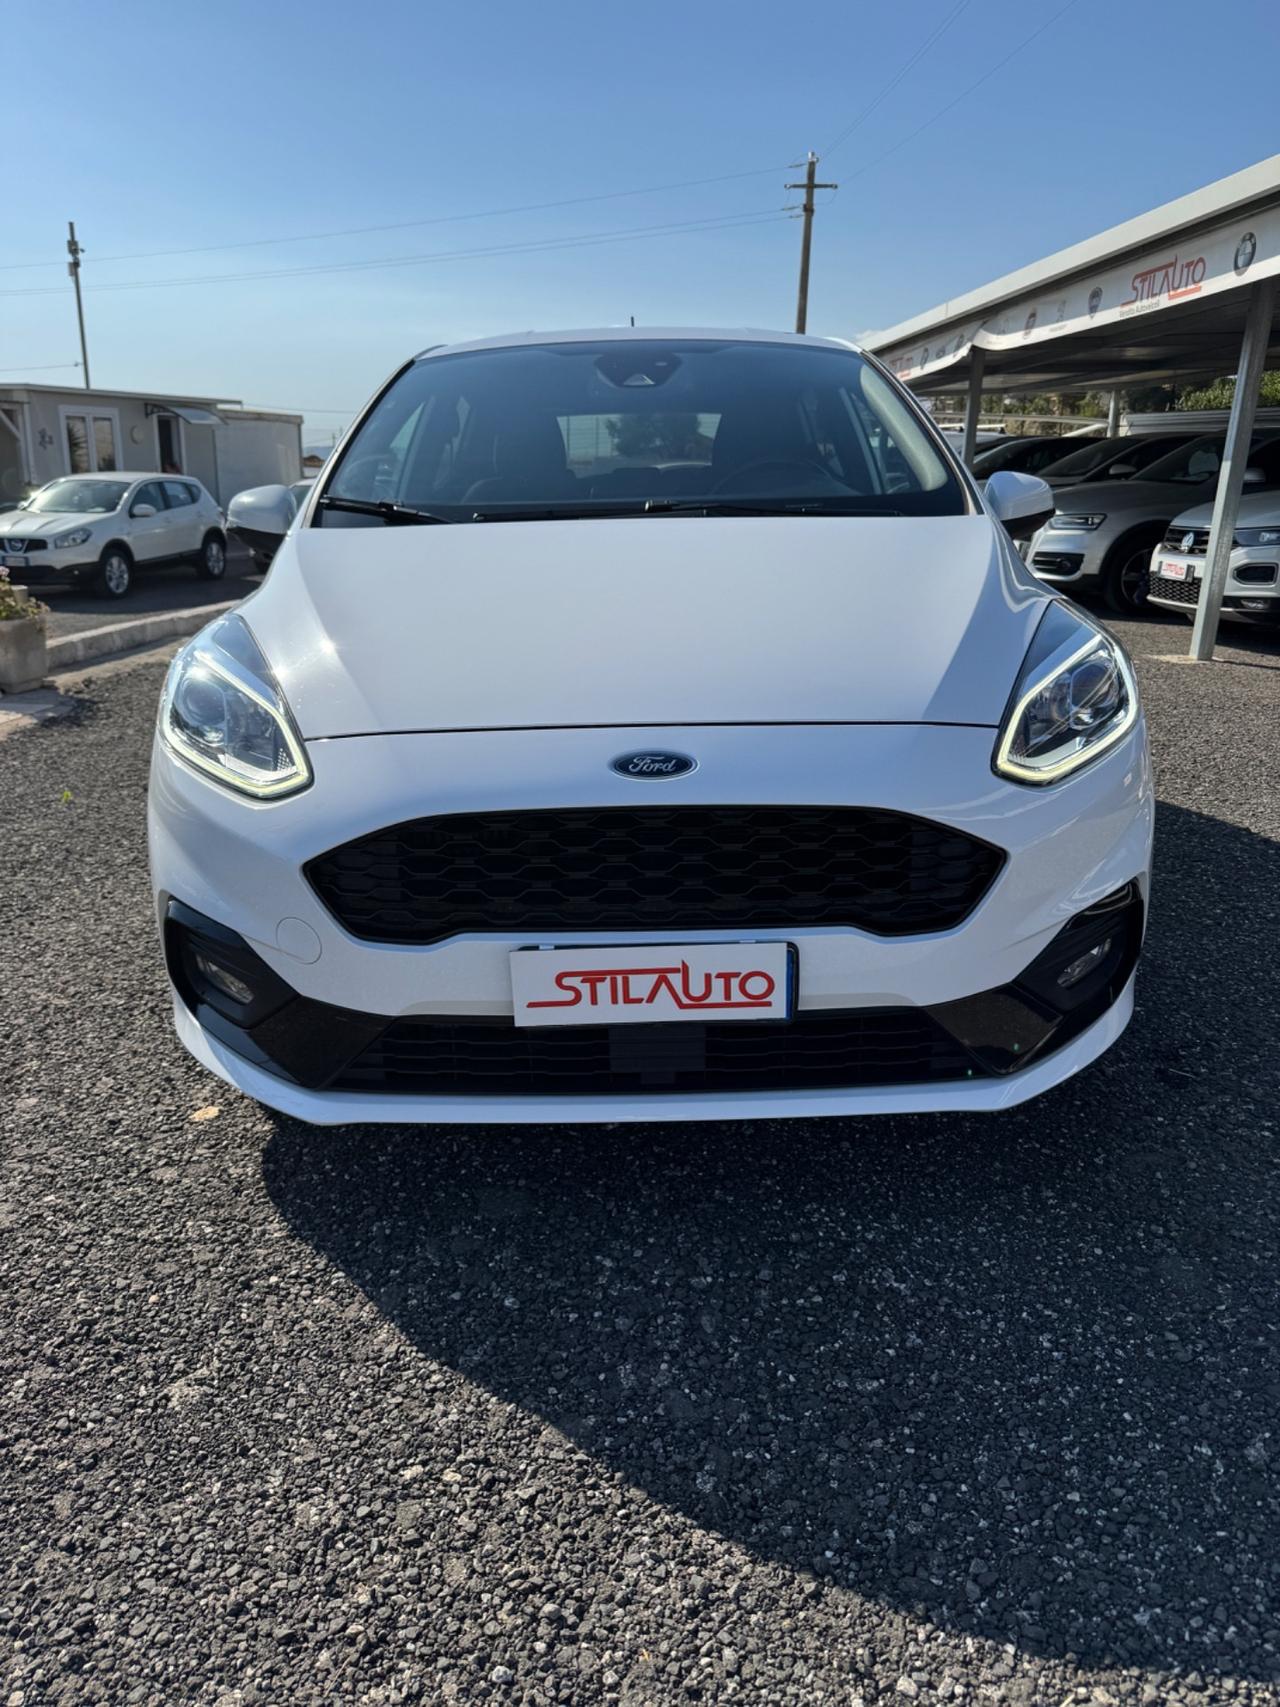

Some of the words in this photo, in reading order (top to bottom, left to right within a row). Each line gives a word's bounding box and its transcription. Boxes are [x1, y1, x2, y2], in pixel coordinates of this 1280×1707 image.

[1120, 254, 1206, 307] STILAUTO
[628, 755, 677, 773] Ford
[526, 959, 775, 1010] STILAUTO
